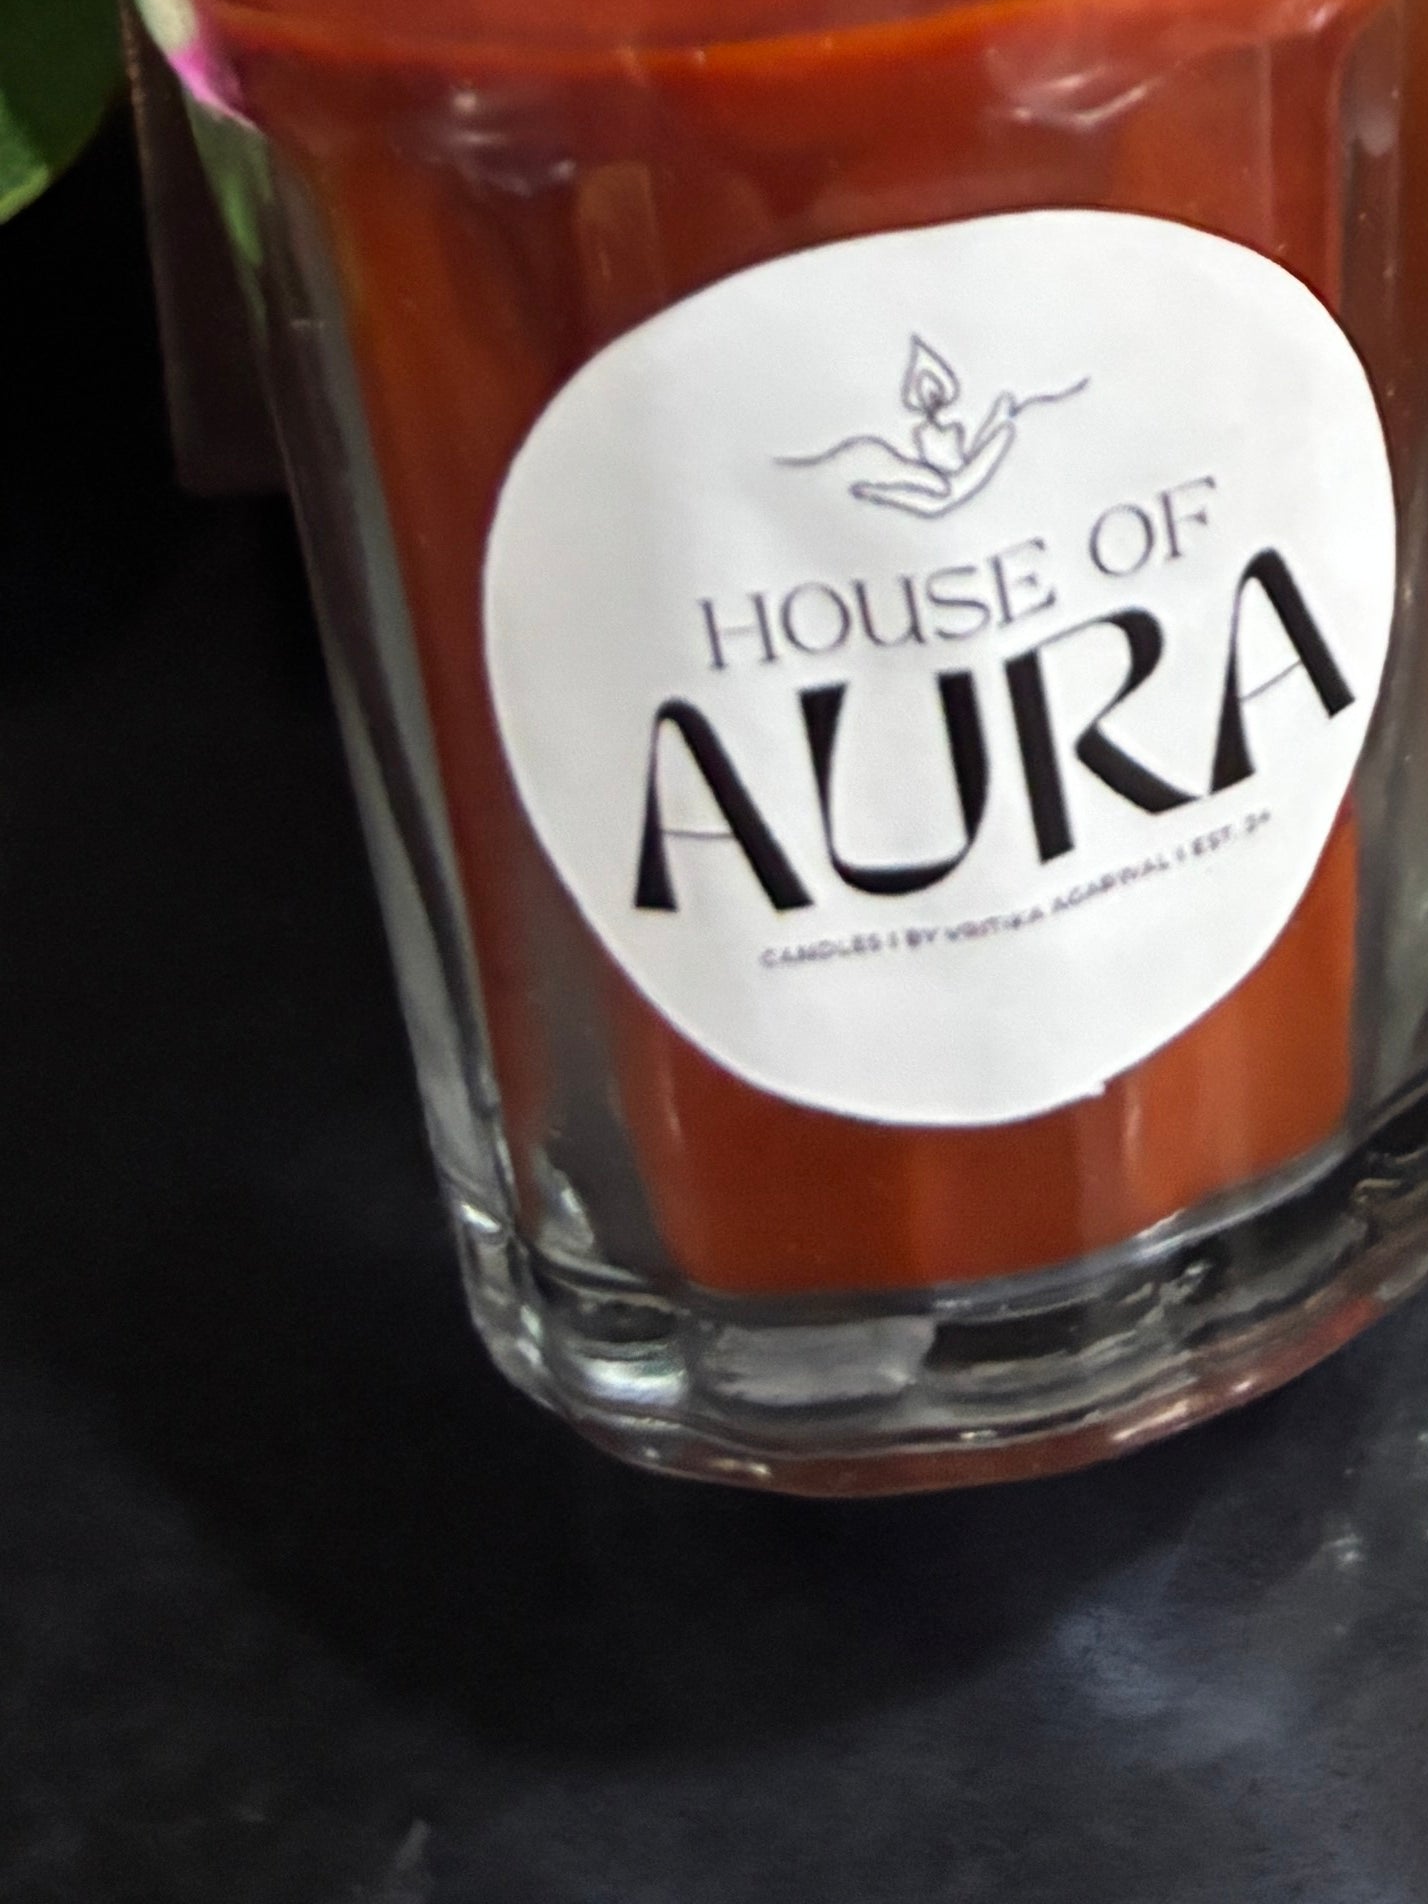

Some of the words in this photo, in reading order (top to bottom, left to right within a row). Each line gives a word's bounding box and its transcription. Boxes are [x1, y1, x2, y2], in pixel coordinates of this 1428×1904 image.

[696, 537, 1059, 674] HOUSE
[1086, 473, 1222, 580] OF
[631, 544, 1357, 915] AURA
[758, 932, 882, 969] CANDLES
